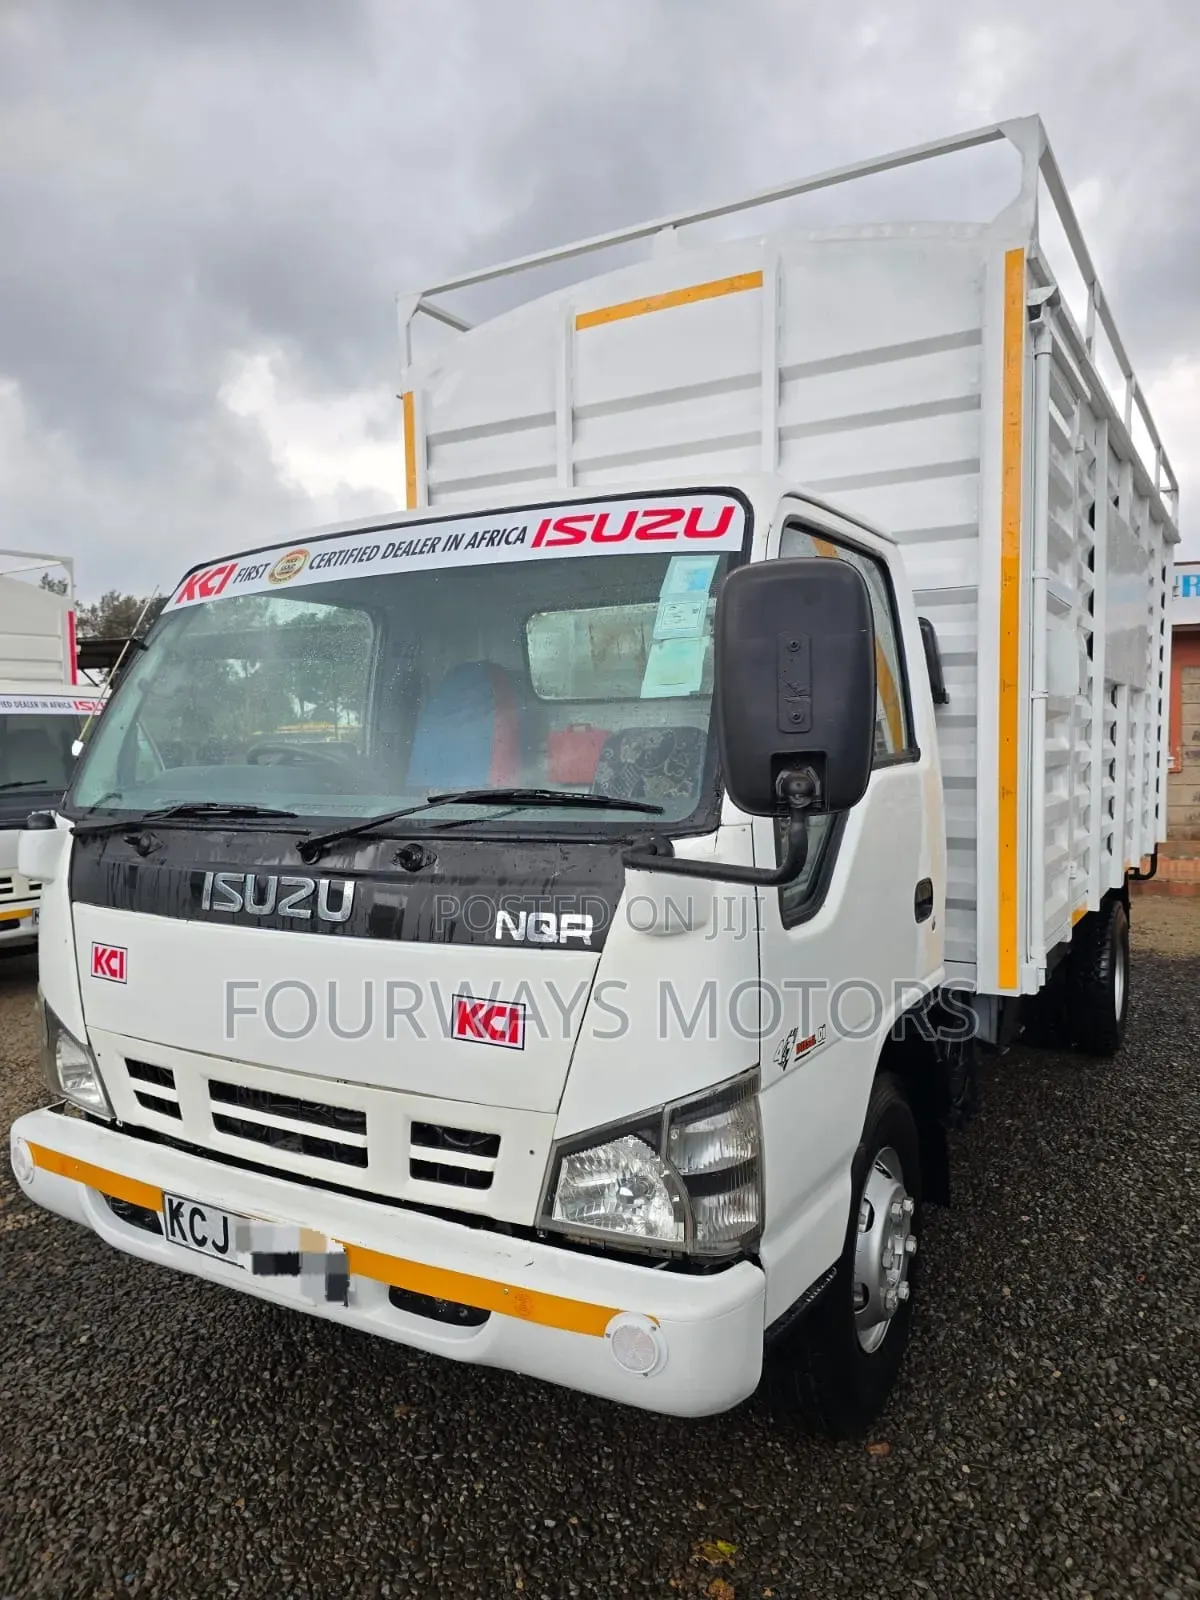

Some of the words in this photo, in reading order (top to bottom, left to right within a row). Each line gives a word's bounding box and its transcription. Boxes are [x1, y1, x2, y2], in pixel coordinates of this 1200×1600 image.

[176, 562, 239, 603] KCI
[233, 562, 271, 584] FIRST
[309, 544, 381, 571] CERTIFIED
[381, 536, 442, 560] DEALER
[444, 533, 461, 552] IN
[464, 525, 528, 550] AFRICA
[531, 505, 736, 549] ISUZU
[201, 871, 356, 923] ISUZU
[495, 910, 594, 945] NQR
[93, 946, 125, 980] KCI
[456, 1000, 520, 1044] KCI
[167, 1197, 229, 1254] KCJ
